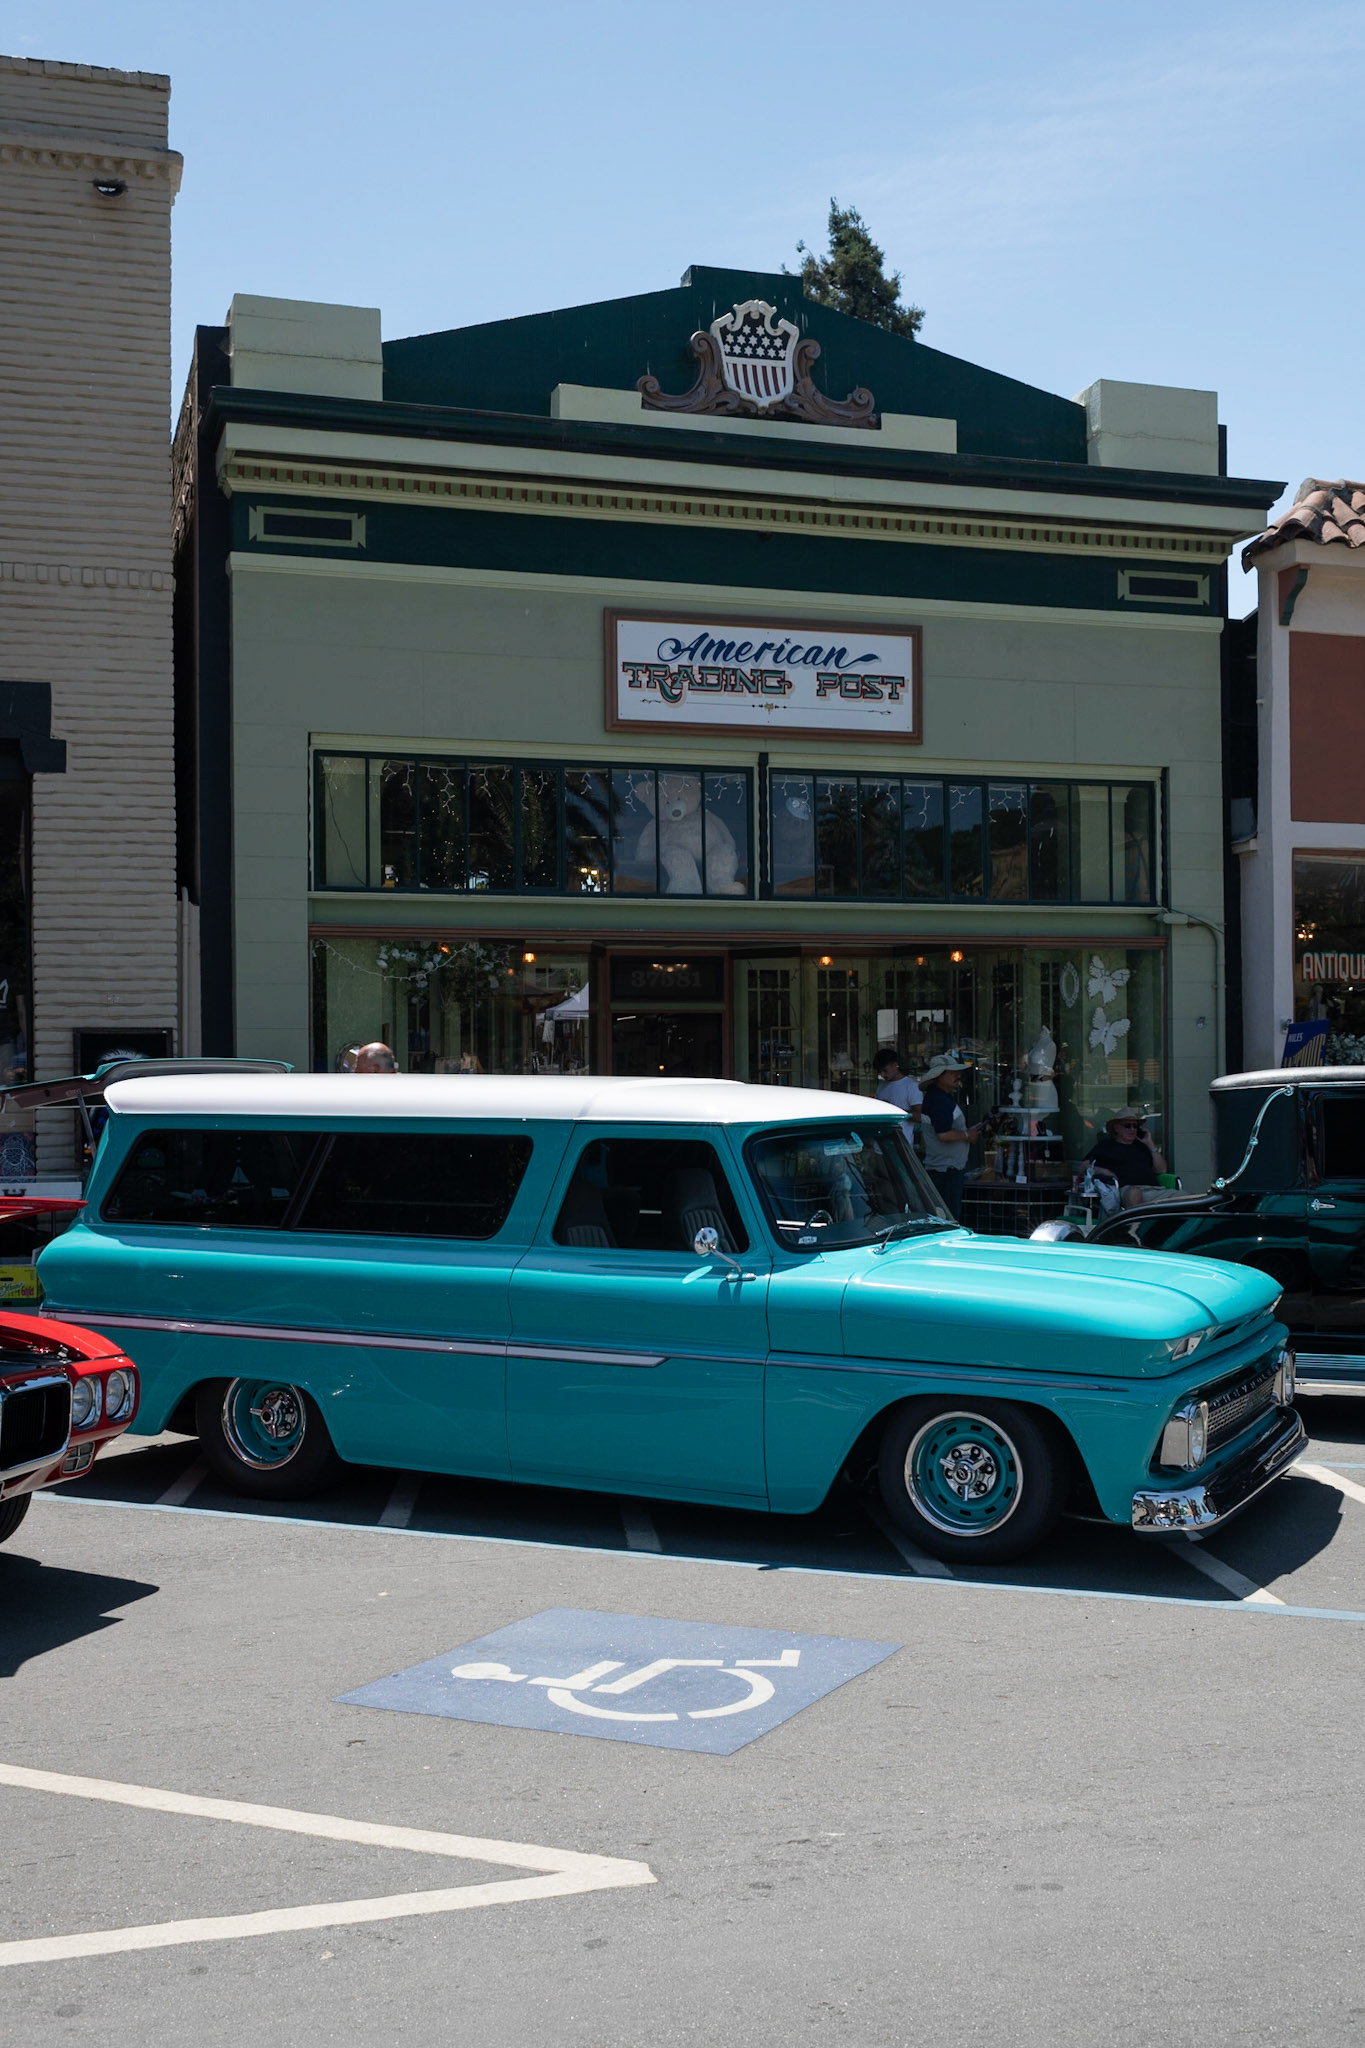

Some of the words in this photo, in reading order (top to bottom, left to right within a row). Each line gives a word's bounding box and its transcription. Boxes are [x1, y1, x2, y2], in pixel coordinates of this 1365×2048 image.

[657, 632, 881, 669] American
[622, 662, 792, 703] TRADING
[816, 671, 905, 699] POST
